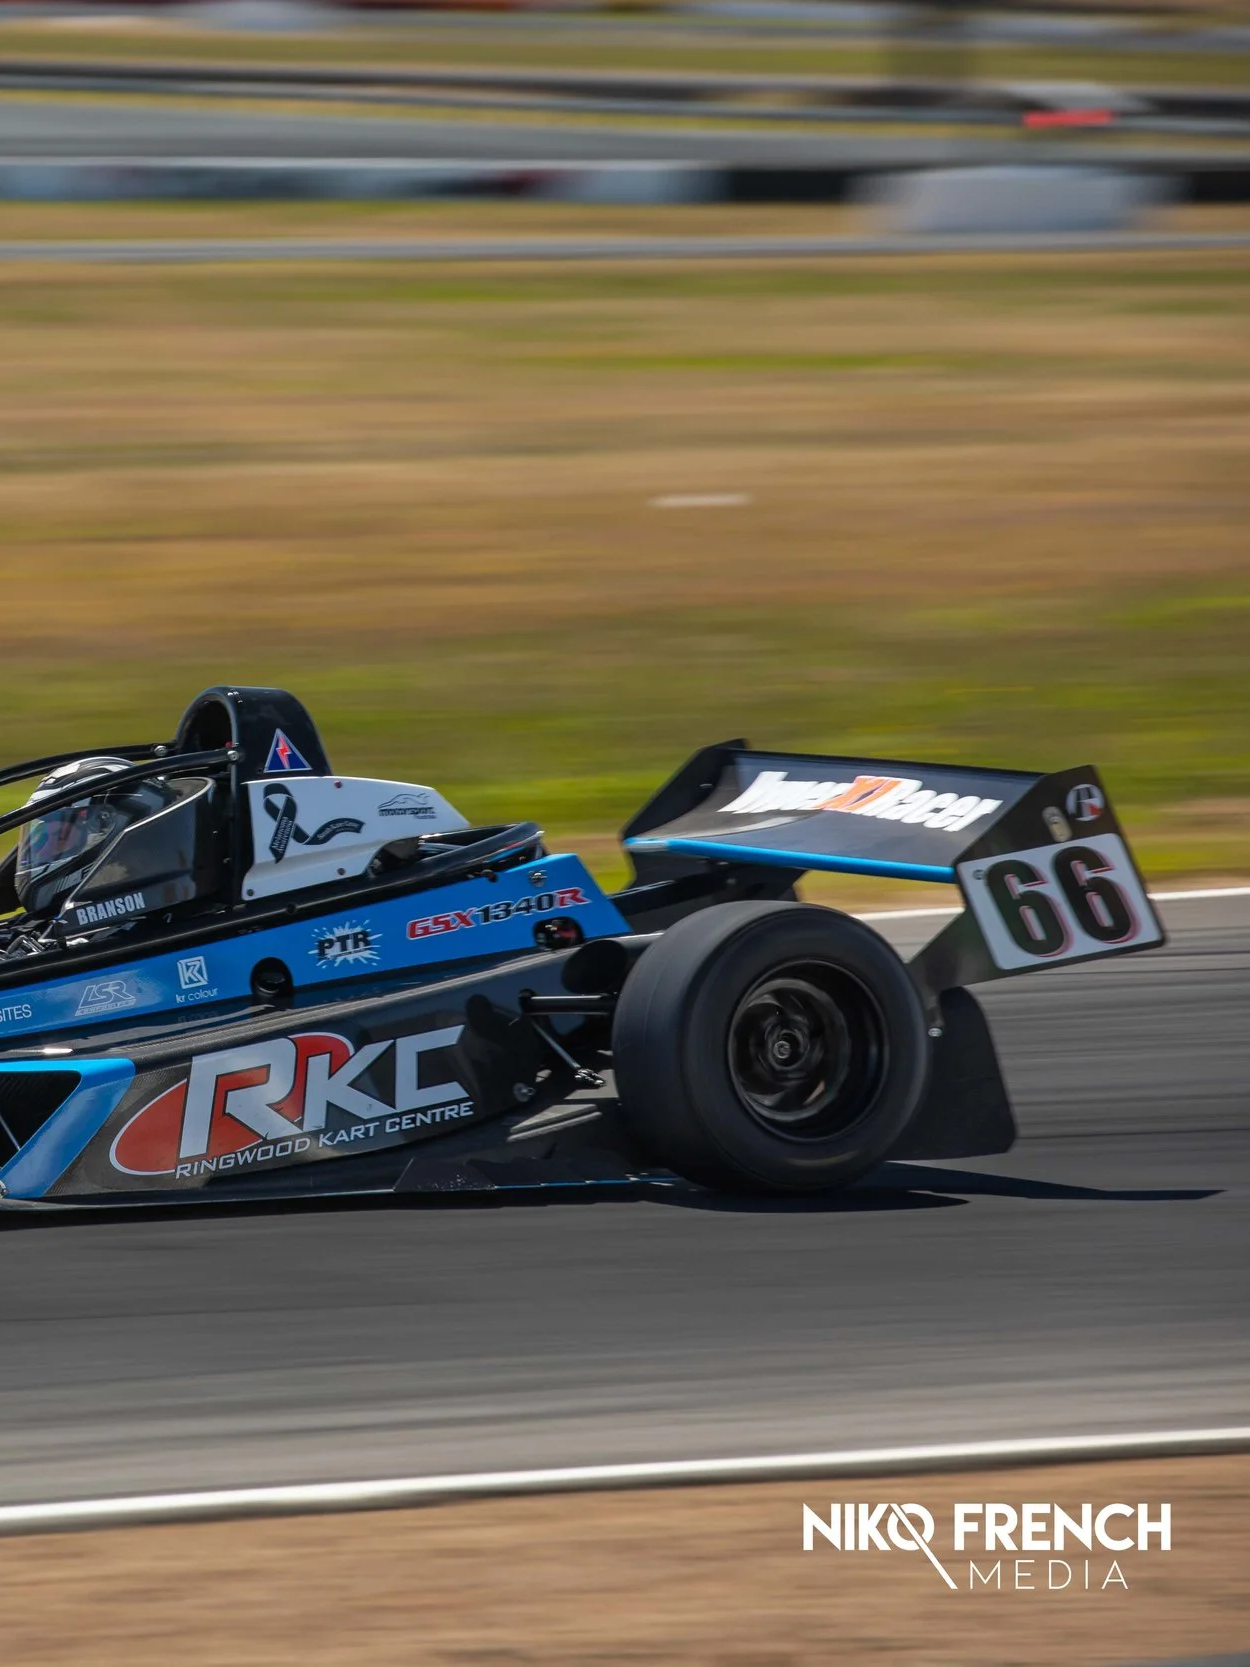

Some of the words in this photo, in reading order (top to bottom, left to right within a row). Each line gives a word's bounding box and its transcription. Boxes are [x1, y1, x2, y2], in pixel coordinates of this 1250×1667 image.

[75, 892, 146, 926] BRANSON
[406, 886, 591, 940] GSX1340R
[985, 844, 1141, 958] 66
[317, 930, 371, 957] PTR
[187, 987, 219, 1001] colour
[179, 1024, 472, 1159] RKC
[175, 1137, 311, 1179] RINGWOOD
[318, 1121, 380, 1148] KART
[384, 1101, 474, 1134] CENTRE
